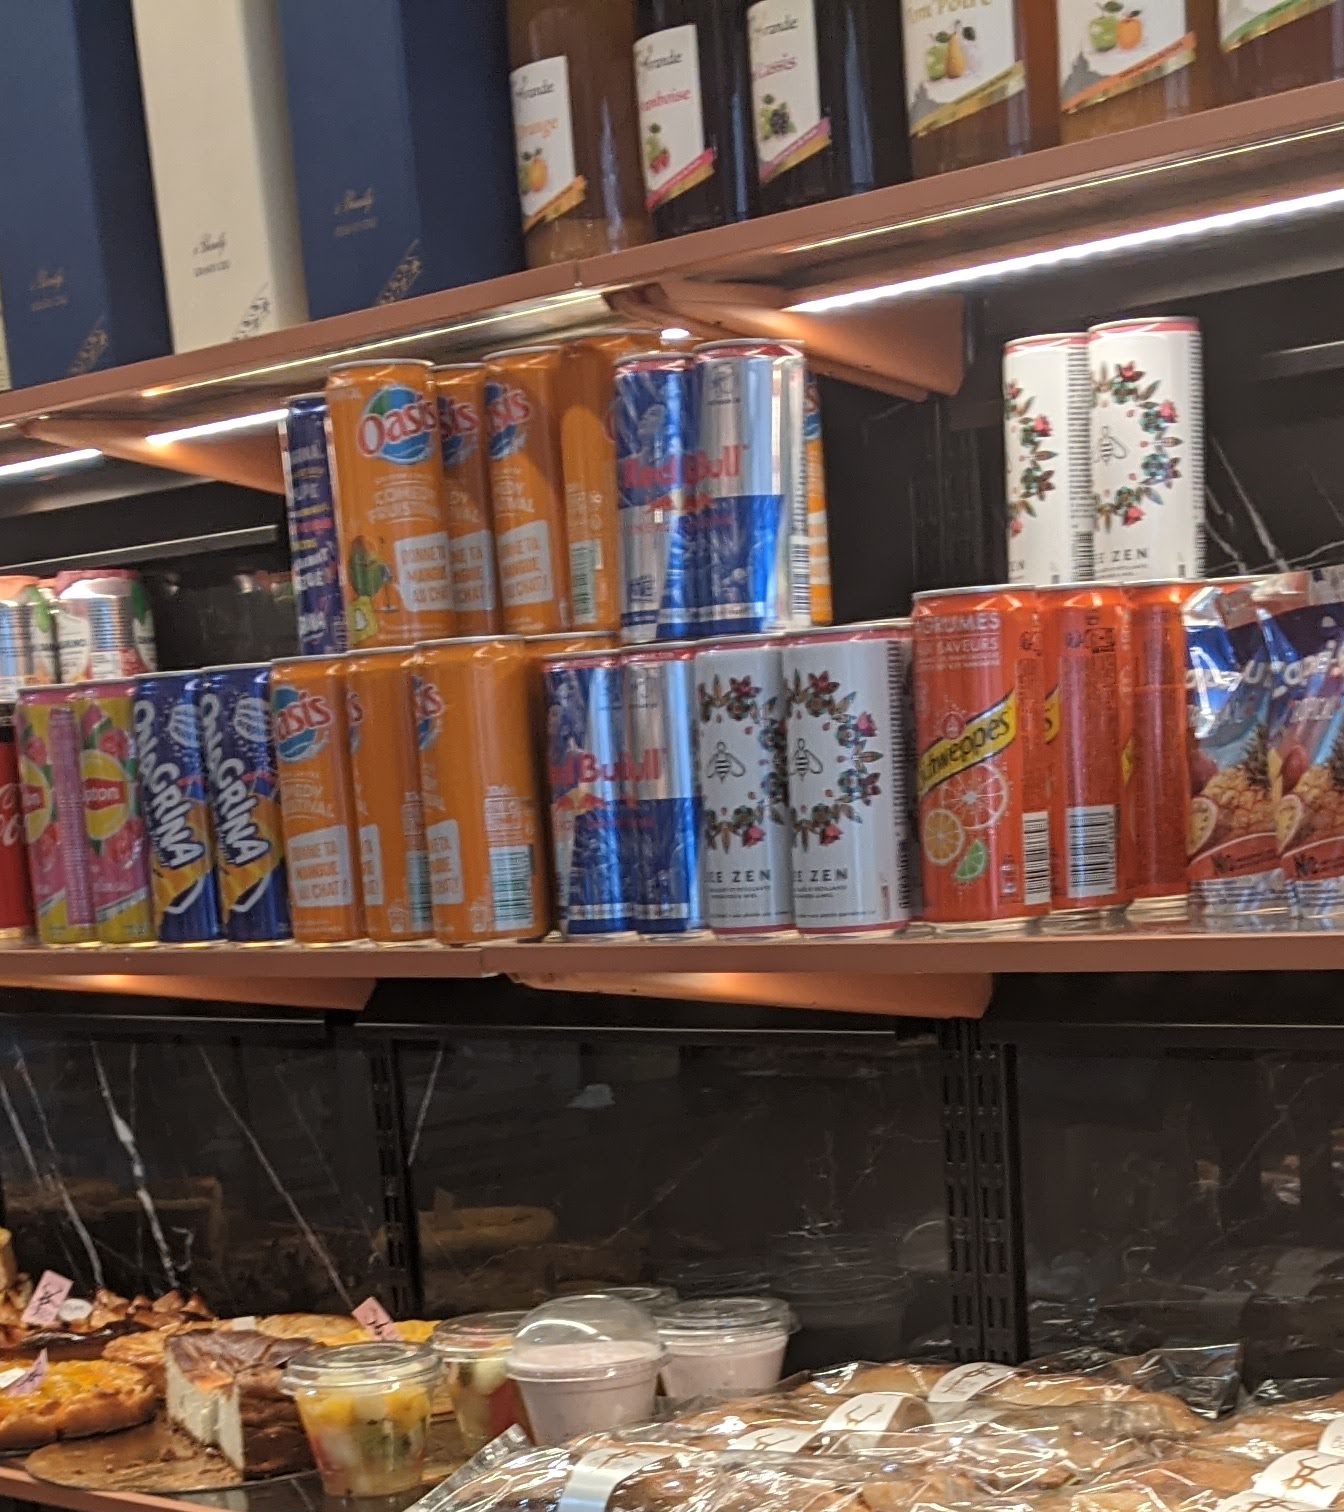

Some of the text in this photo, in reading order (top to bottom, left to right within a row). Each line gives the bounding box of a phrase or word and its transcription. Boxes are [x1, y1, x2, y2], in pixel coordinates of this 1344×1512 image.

[274, 690, 334, 741] asis
[707, 868, 772, 883] EE ZEN
[810, 867, 849, 882] ZEN
